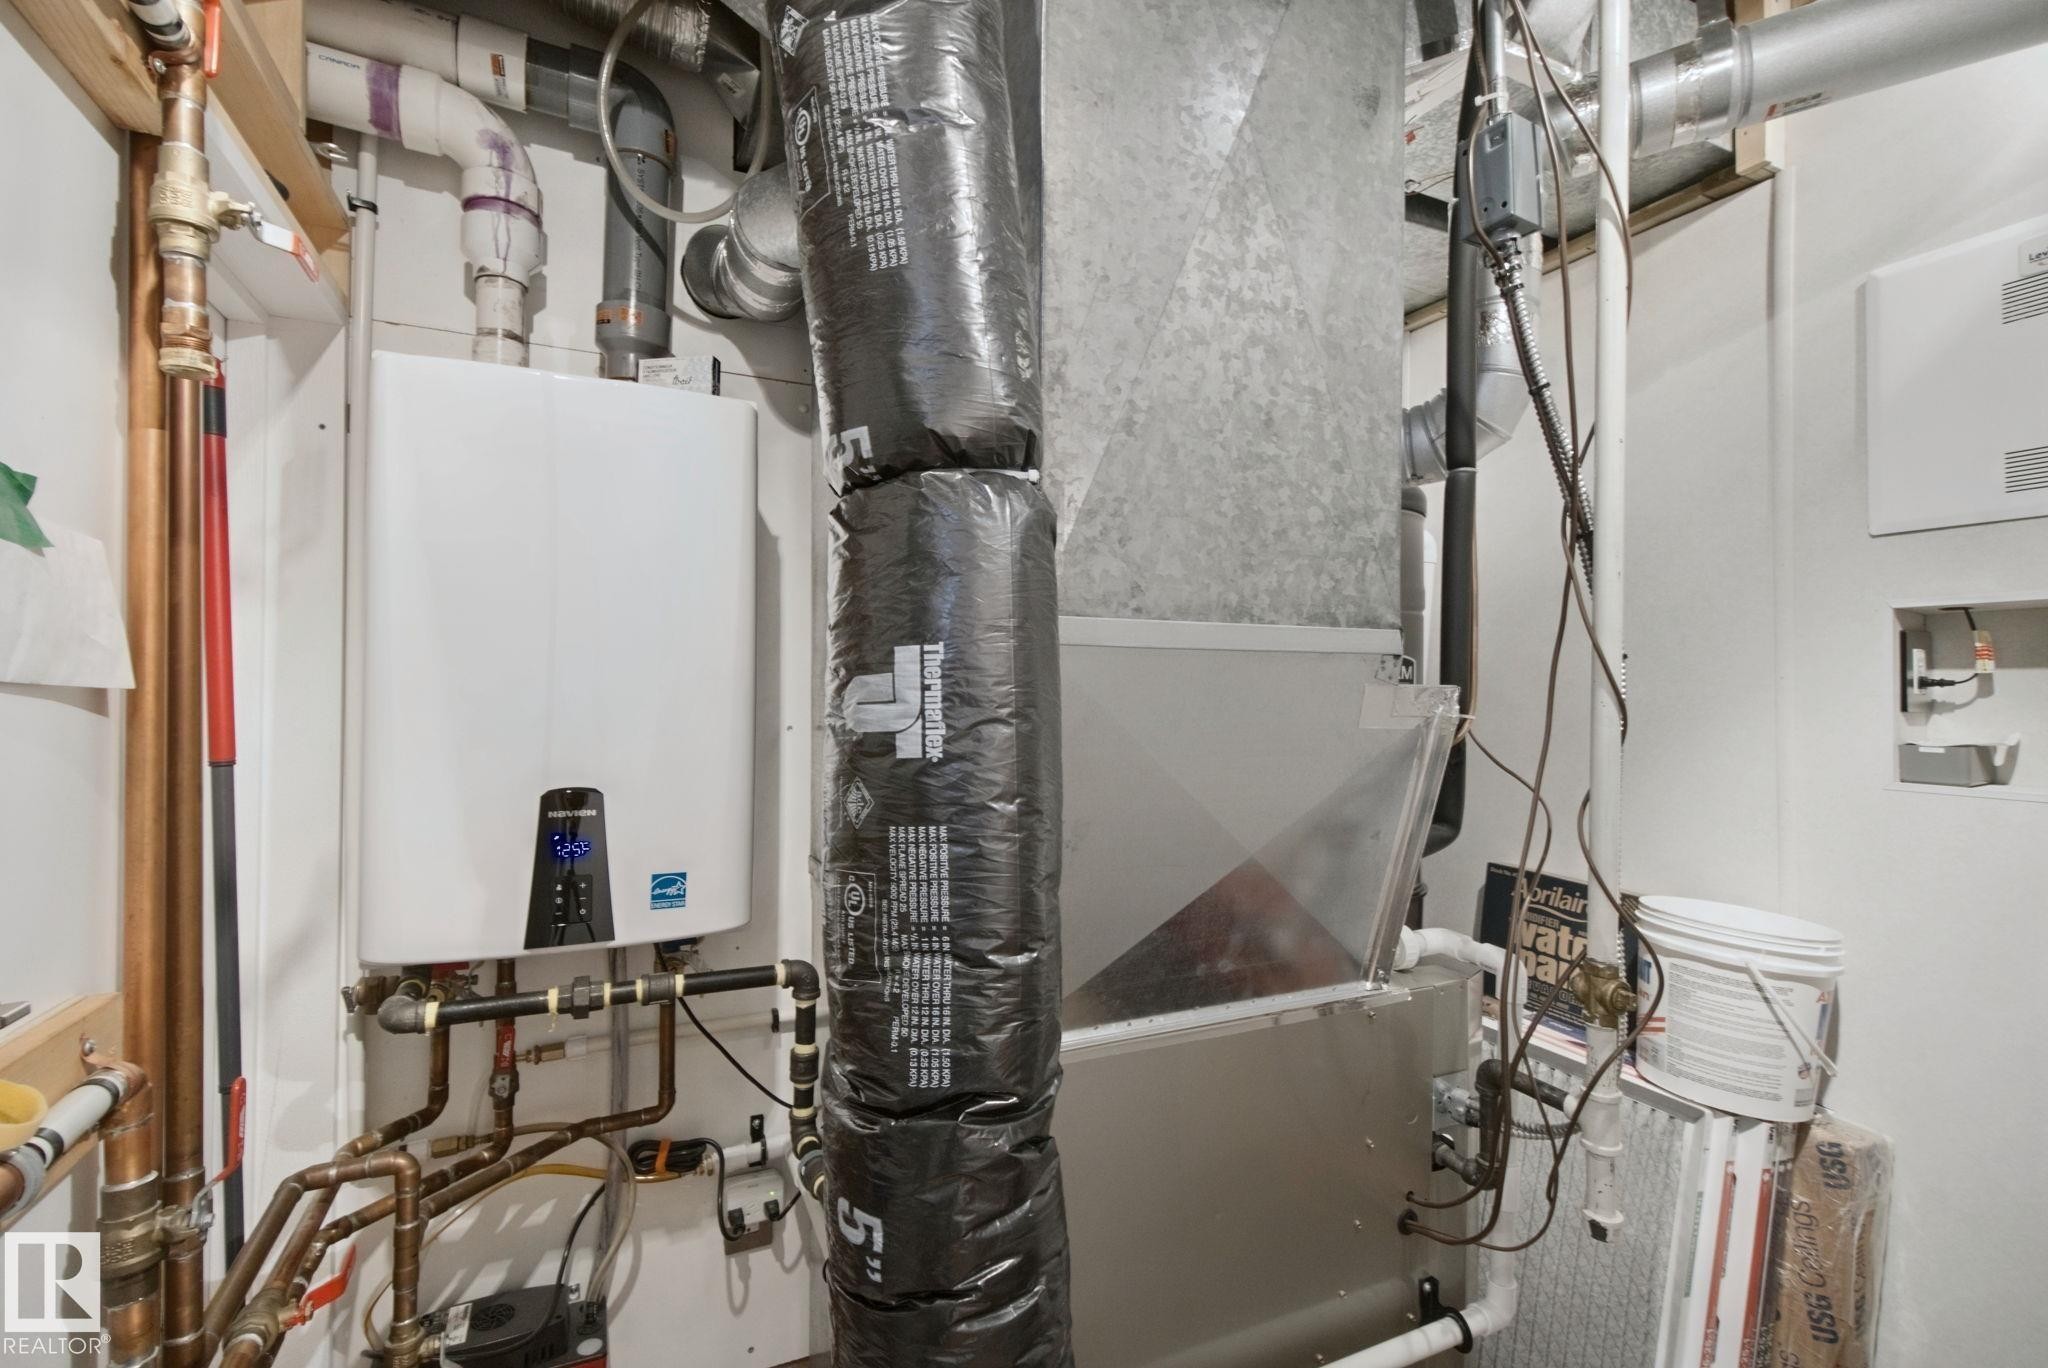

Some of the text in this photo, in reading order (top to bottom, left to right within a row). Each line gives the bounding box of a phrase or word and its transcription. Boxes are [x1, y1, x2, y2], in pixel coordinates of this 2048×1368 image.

[924, 641, 946, 758] Thermaflex
[908, 826, 916, 842] MAX
[918, 826, 926, 842] MAX
[928, 826, 936, 842] MAX
[940, 826, 948, 842] MAX
[889, 844, 897, 880] VELOCITY
[898, 844, 906, 869] FLAME
[908, 844, 916, 880] NEGATIVE
[919, 844, 928, 880] NEGATIVE
[929, 844, 938, 878] POSITIVE
[940, 844, 948, 878] POSITIVE
[890, 882, 898, 899] 5000
[899, 871, 907, 901] SPREAD
[1511, 877, 1587, 914] Aprilair
[890, 901, 898, 916] FPM
[900, 903, 908, 912] 25
[909, 882, 918, 922] PRESSURE
[920, 882, 928, 922] PRESSURE
[930, 880, 938, 922] PRESSURE
[941, 880, 950, 922] PRESSURE
[911, 952, 920, 980] WATER
[922, 953, 931, 980] WATER
[932, 952, 941, 980] WATER
[943, 954, 952, 980] WATER
[900, 978, 910, 1026] DEVELOPED
[912, 982, 920, 1004] OVER
[922, 982, 930, 1004] THRU
[932, 982, 940, 1004] OVER
[942, 982, 951, 1004] THRU
[911, 1006, 919, 1014] 12
[921, 1006, 929, 1014] 12
[890, 1016, 900, 1053] PERM-0.1
[900, 1027, 908, 1036] 50
[910, 1028, 918, 1043] DIA.
[920, 1029, 929, 1044] DIA.
[931, 1030, 940, 1044] DIA.
[942, 1029, 950, 1044] DIA.
[908, 1048, 918, 1066] (0.13
[920, 1048, 929, 1068] (0.25
[930, 1048, 940, 1068] (1.05
[942, 1048, 951, 1067] (1.50
[908, 1068, 917, 1087] KPA)
[920, 1070, 928, 1088] KPA)
[930, 1070, 939, 1088] KPA)
[940, 1069, 950, 1087] KPA)
[1815, 1142, 1850, 1190] USG
[1802, 1292, 1838, 1344] USG
